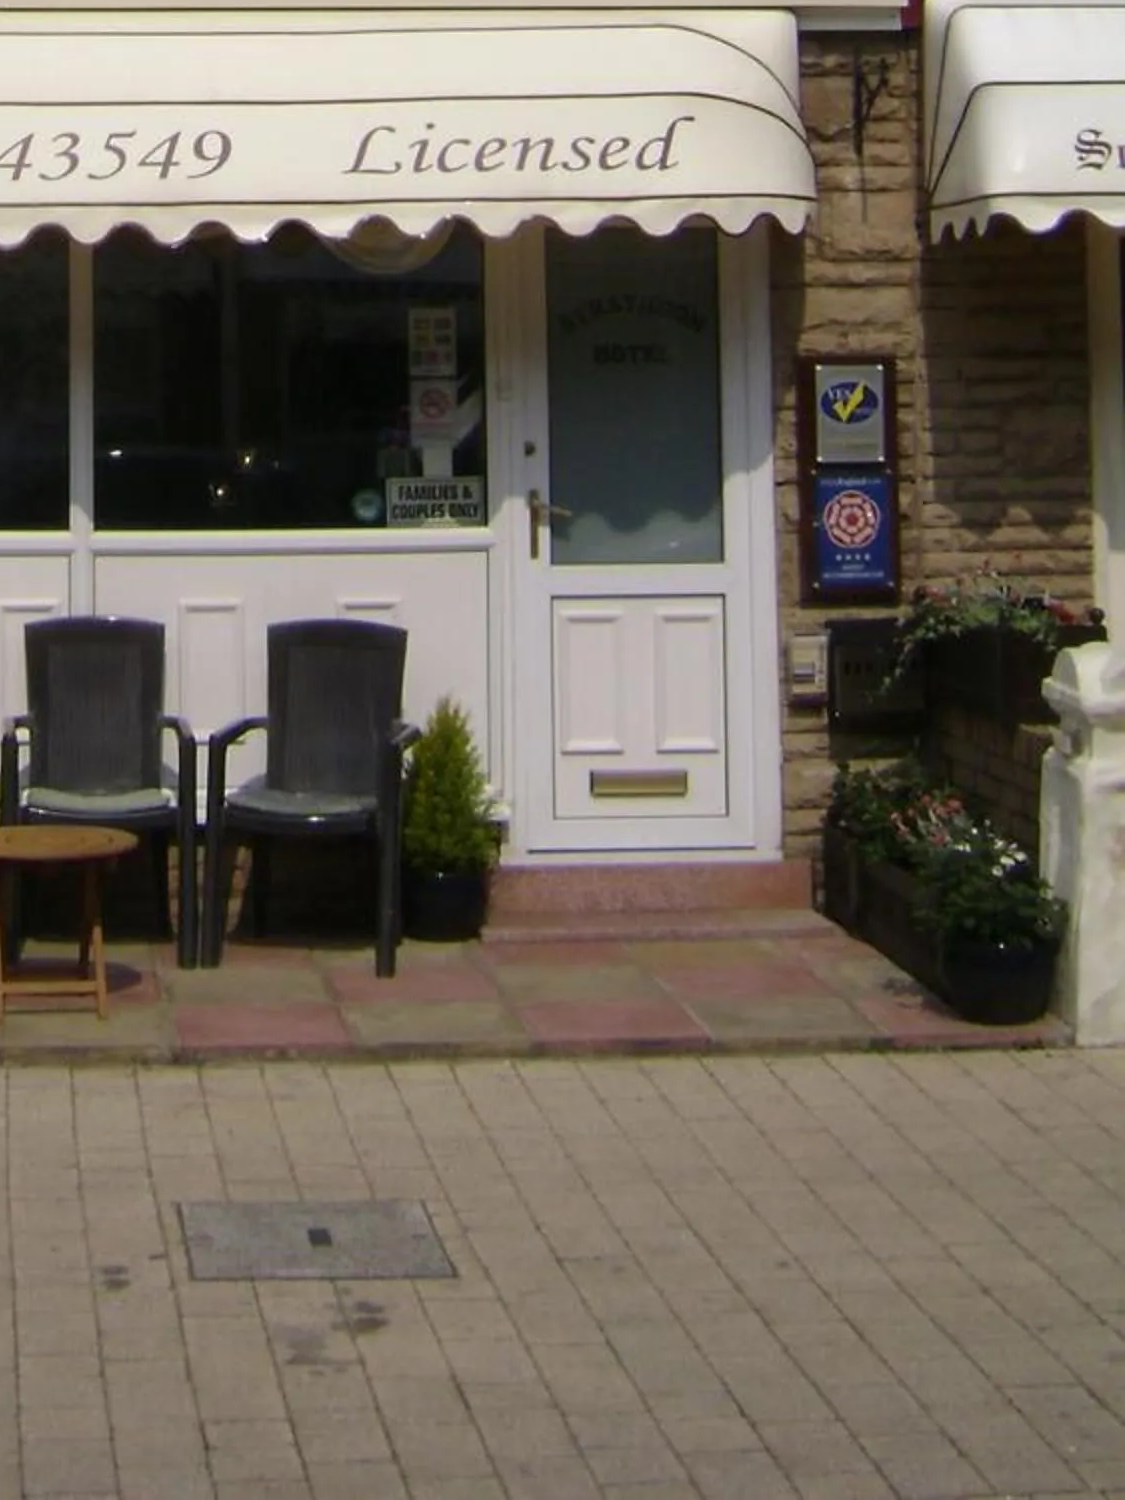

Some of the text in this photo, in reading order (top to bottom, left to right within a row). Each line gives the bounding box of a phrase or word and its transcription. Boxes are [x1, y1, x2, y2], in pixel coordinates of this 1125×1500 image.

[344, 116, 696, 176] Licensed
[1074, 128, 1125, 172] S
[392, 502, 446, 519] COUPLES
